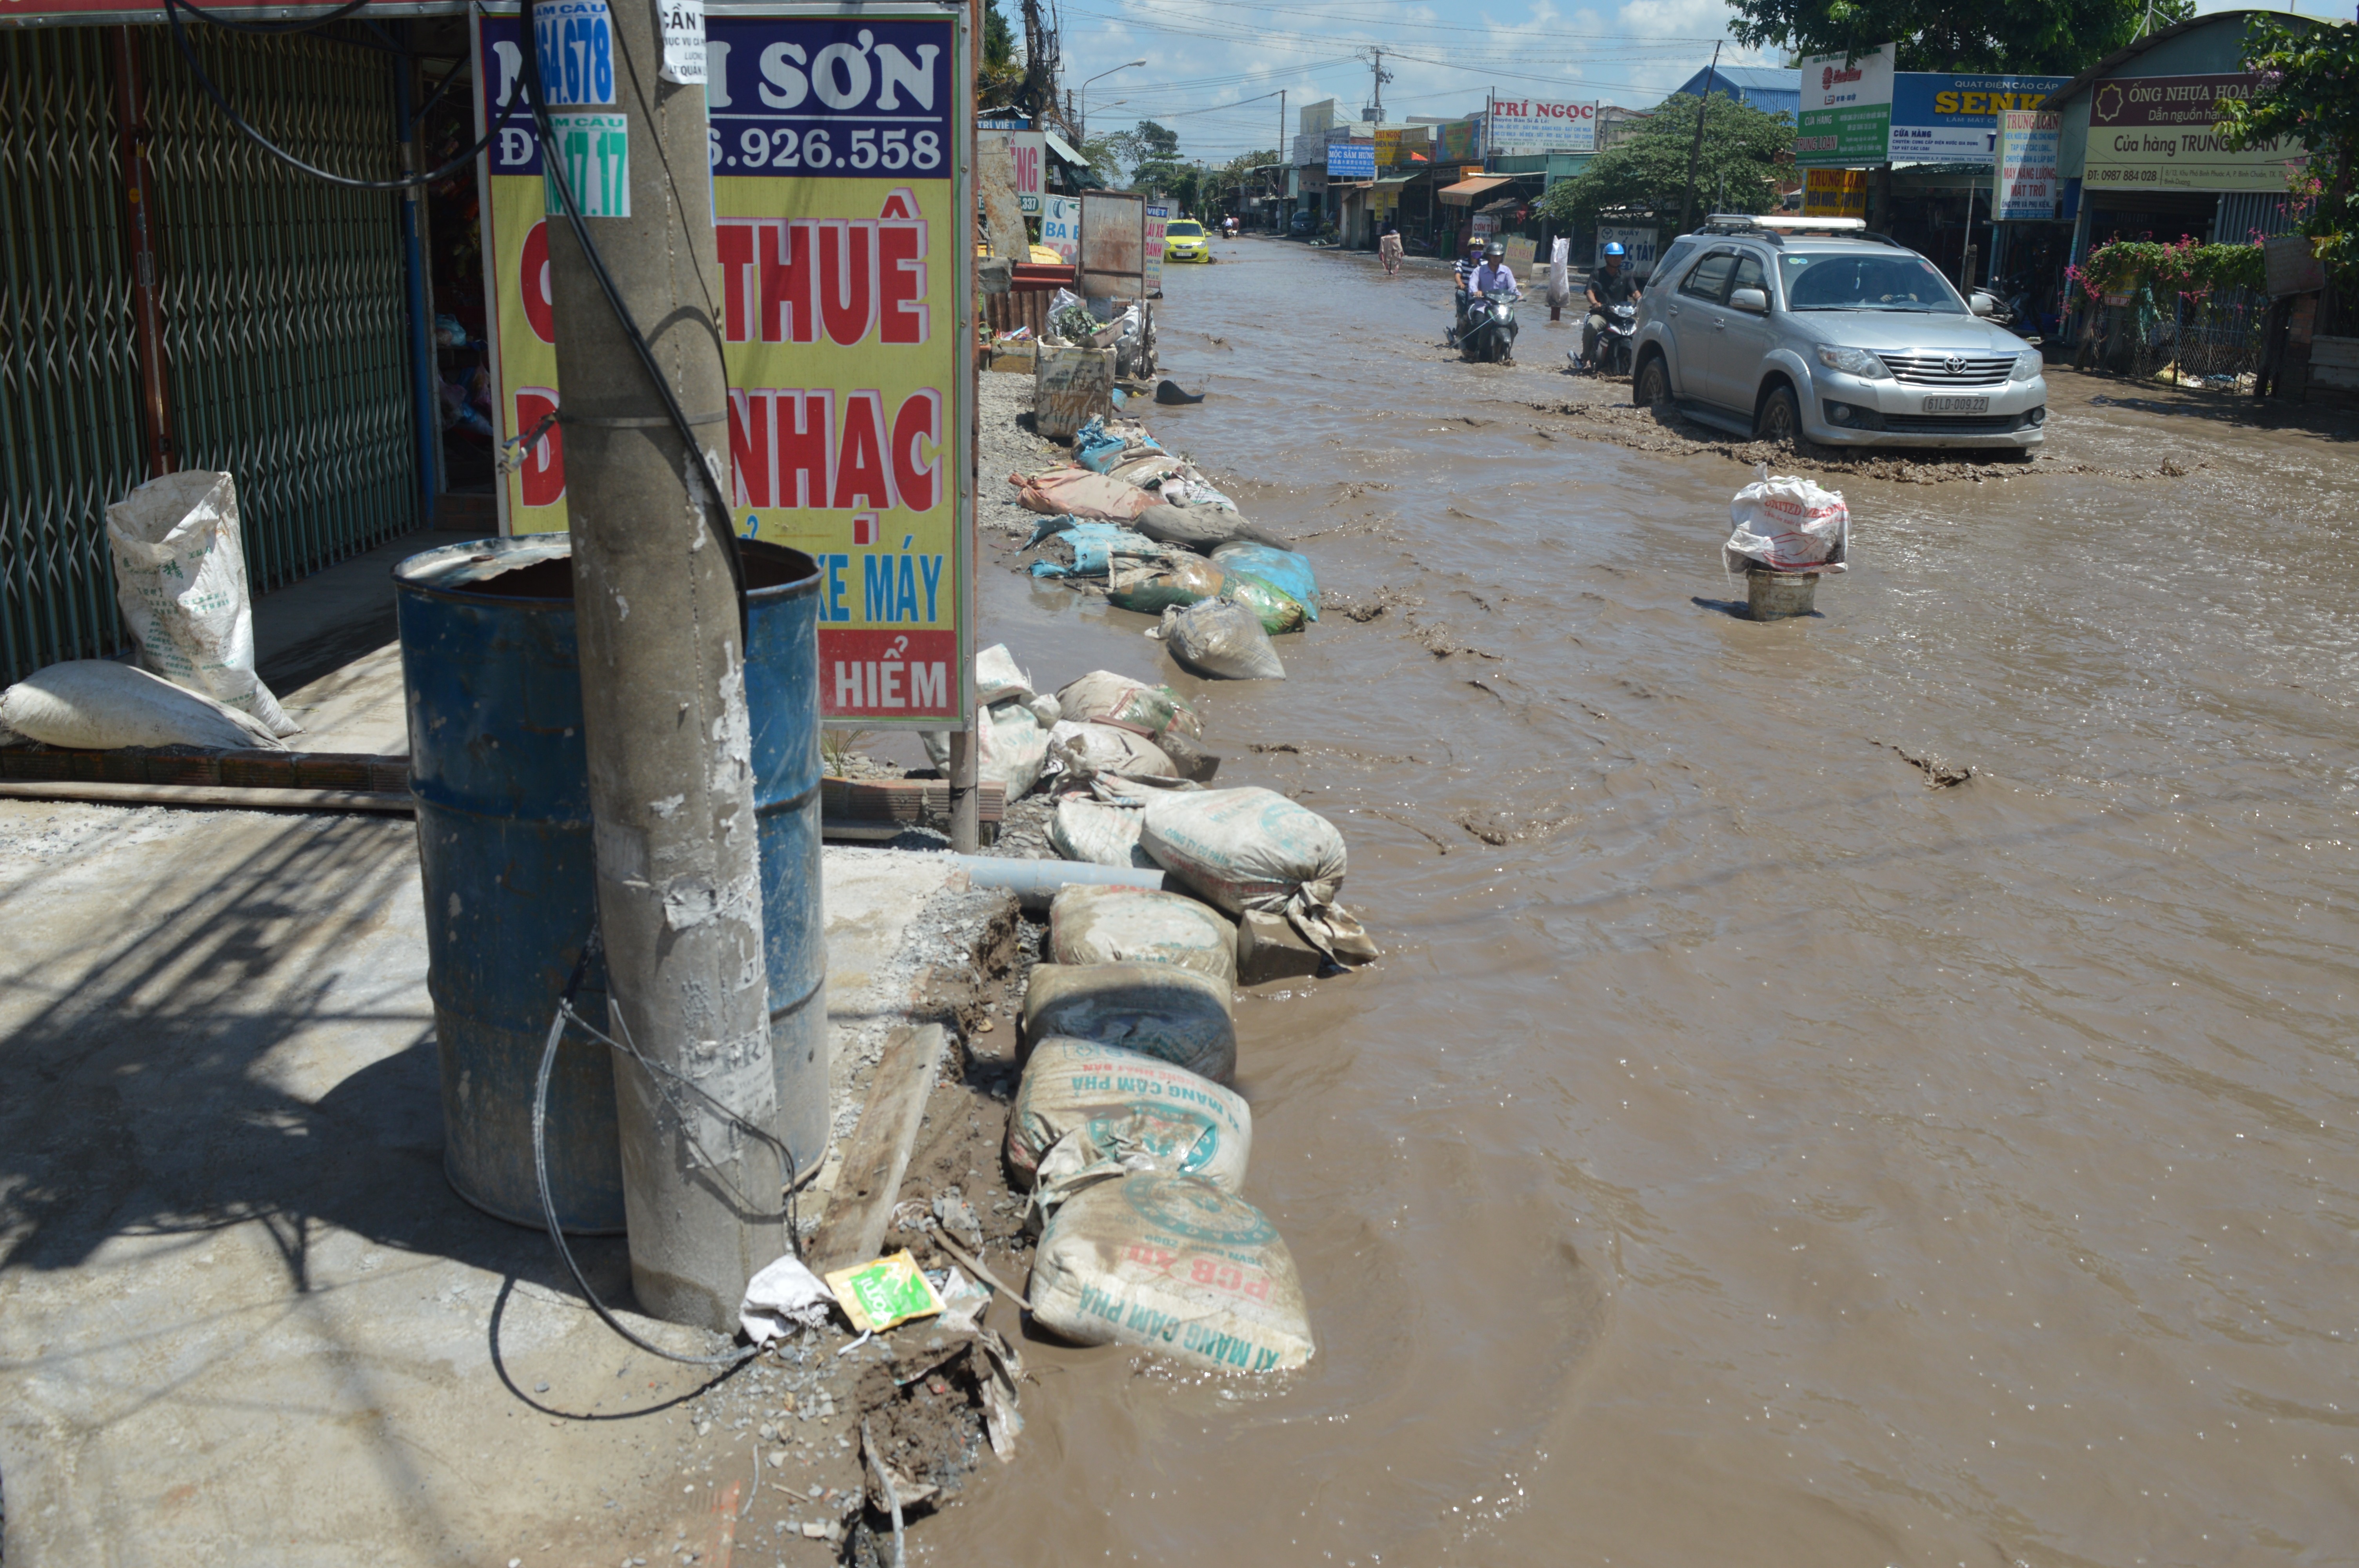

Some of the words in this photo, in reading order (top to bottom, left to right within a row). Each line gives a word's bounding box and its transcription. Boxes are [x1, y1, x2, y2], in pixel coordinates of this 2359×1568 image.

[758, 29, 940, 111] SƠN
[1955, 81, 1984, 89] QUẠT
[1985, 80, 2010, 90] ĐIỆN
[2036, 80, 2059, 90] CẤP
[2129, 81, 2162, 102] ỐNG
[2165, 83, 2210, 105] NHỰA
[2215, 84, 2249, 100] HOA
[1494, 99, 1528, 116] TRÍ
[1536, 103, 1594, 123] NGỌC
[1934, 91, 2046, 115] SENK
[1817, 113, 1832, 124] HÀNG
[2007, 114, 2035, 130] TRUNG
[2036, 114, 2059, 130] LOAN
[2148, 106, 2168, 121] Dẫn
[2170, 106, 2201, 122] nguồn
[978, 120, 992, 129] TRÍ
[995, 119, 1016, 130] VIỆT
[1894, 129, 1910, 137] CỬA
[1911, 129, 1932, 138] HÀNG
[1386, 131, 1401, 140] NGỌC
[1796, 138, 1817, 152] TRUNG
[1818, 135, 1838, 151] LOAN
[2114, 133, 2138, 152] Cửa
[2143, 134, 2176, 157] hàng
[2181, 134, 2231, 152] TRUNG
[1329, 149, 1342, 160] MỘC
[1343, 150, 1357, 158] SÂM
[1358, 151, 1374, 159] HƯNG
[1810, 170, 1840, 187] TRUNG
[1842, 171, 1866, 189] LOAN
[2003, 164, 2016, 180] MÁY
[2017, 165, 2034, 180] NĂNG
[2036, 165, 2055, 182] LƯỢNG
[2087, 170, 2099, 180] ĐT:
[2101, 170, 2121, 181] 0987
[2123, 171, 2139, 181] 884
[2141, 171, 2157, 181] 028
[1807, 188, 1820, 208] ĐIỆN
[2011, 181, 2026, 199] MẶT
[2029, 181, 2046, 196] TRỜI
[1147, 207, 1166, 217] VIỆT
[2022, 199, 2027, 208] VÀ
[1045, 221, 1067, 238] BA
[1156, 224, 1164, 238] XE
[1474, 222, 1485, 231] CƠM
[1637, 240, 1656, 261] TÂY
[714, 186, 931, 347] THUÊ
[1928, 398, 1985, 410] 61LD-009.22
[727, 387, 943, 545] NHẠC
[1765, 499, 1802, 515] UNITED
[864, 535, 943, 622] MÁY
[834, 635, 947, 708] HIỂM
[1164, 827, 1185, 845] CÔNG
[1187, 838, 1197, 850] TY
[1071, 1076, 1111, 1098] PHẢ
[1117, 1076, 1162, 1097] CẨM
[1167, 1085, 1224, 1115] MĂNG
[1189, 1257, 1271, 1301] PCB
[1075, 1283, 1125, 1323] PHẢ
[1125, 1303, 1181, 1346] CẨM
[1182, 1322, 1252, 1368] MĂNG
[1253, 1346, 1280, 1371] XI
